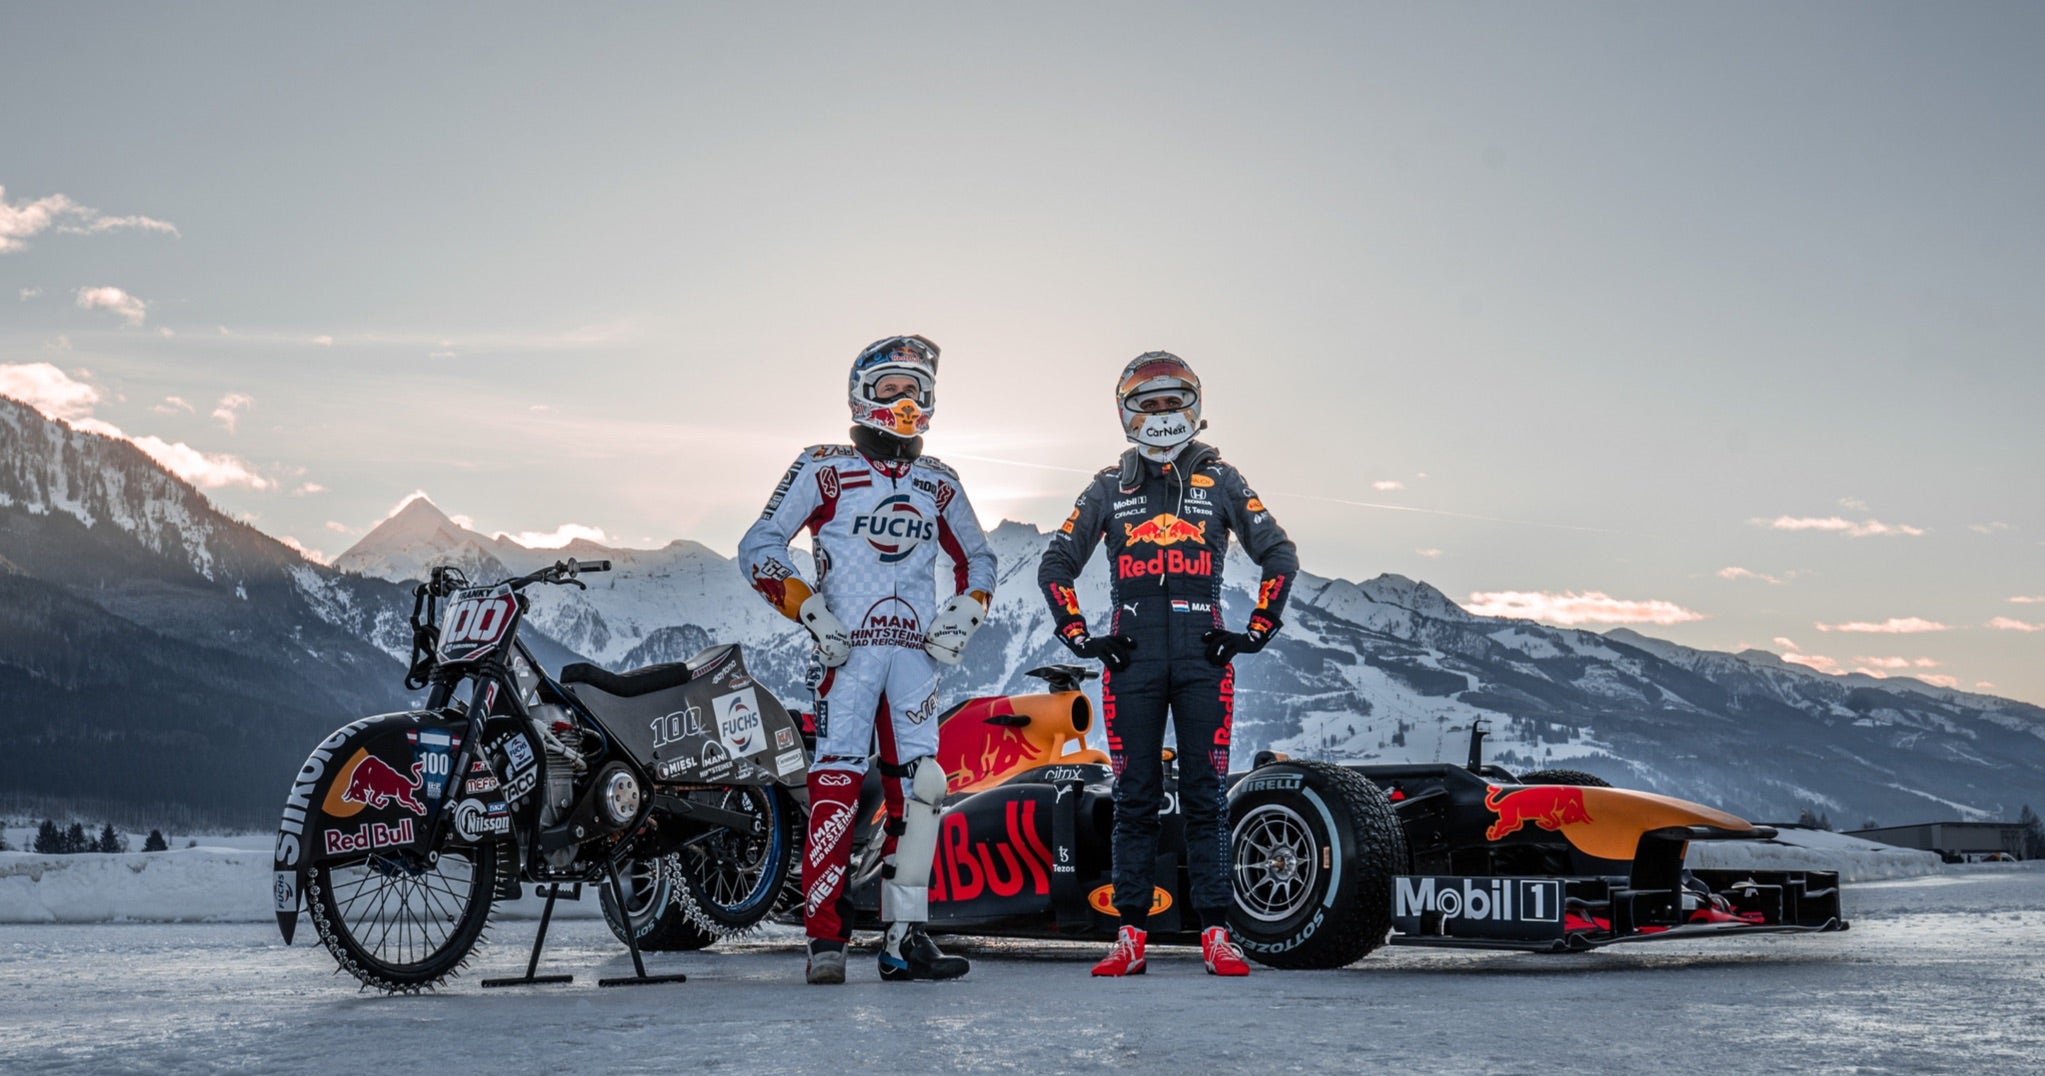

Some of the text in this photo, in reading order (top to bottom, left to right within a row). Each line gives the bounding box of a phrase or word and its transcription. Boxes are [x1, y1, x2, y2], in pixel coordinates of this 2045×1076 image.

[1146, 425, 1187, 438] CarNext
[1113, 497, 1137, 511] Mobil
[1114, 507, 1147, 520] ORACLE
[1184, 498, 1213, 507] HONDA
[1192, 506, 1213, 516] Tezos
[852, 516, 934, 541] FUCHS
[761, 558, 794, 582] 69
[1118, 549, 1212, 579] Red Bull
[1191, 602, 1212, 612] MAX
[870, 615, 916, 631] MAN
[871, 638, 926, 651] REICHENHA
[711, 660, 737, 685] daytona
[650, 706, 702, 749] 100
[722, 712, 759, 738] FUCHS
[509, 741, 528, 757] FUCHS
[419, 751, 449, 776] 100
[669, 756, 698, 775] MIESL
[704, 754, 725, 767] MAN
[1044, 765, 1083, 780] citrix
[1241, 772, 1304, 794] PIRELLI
[467, 812, 510, 834] Nilsson
[809, 798, 859, 861] HINTSTEINER
[813, 808, 846, 842] MAN
[324, 817, 415, 855] Red Bull
[812, 853, 825, 869] BAD
[943, 800, 1053, 902] Bull
[1052, 863, 1076, 873] Tezos
[276, 873, 285, 909] FUCHS
[809, 865, 847, 908] MIESL
[1395, 877, 1512, 921] Mobil
